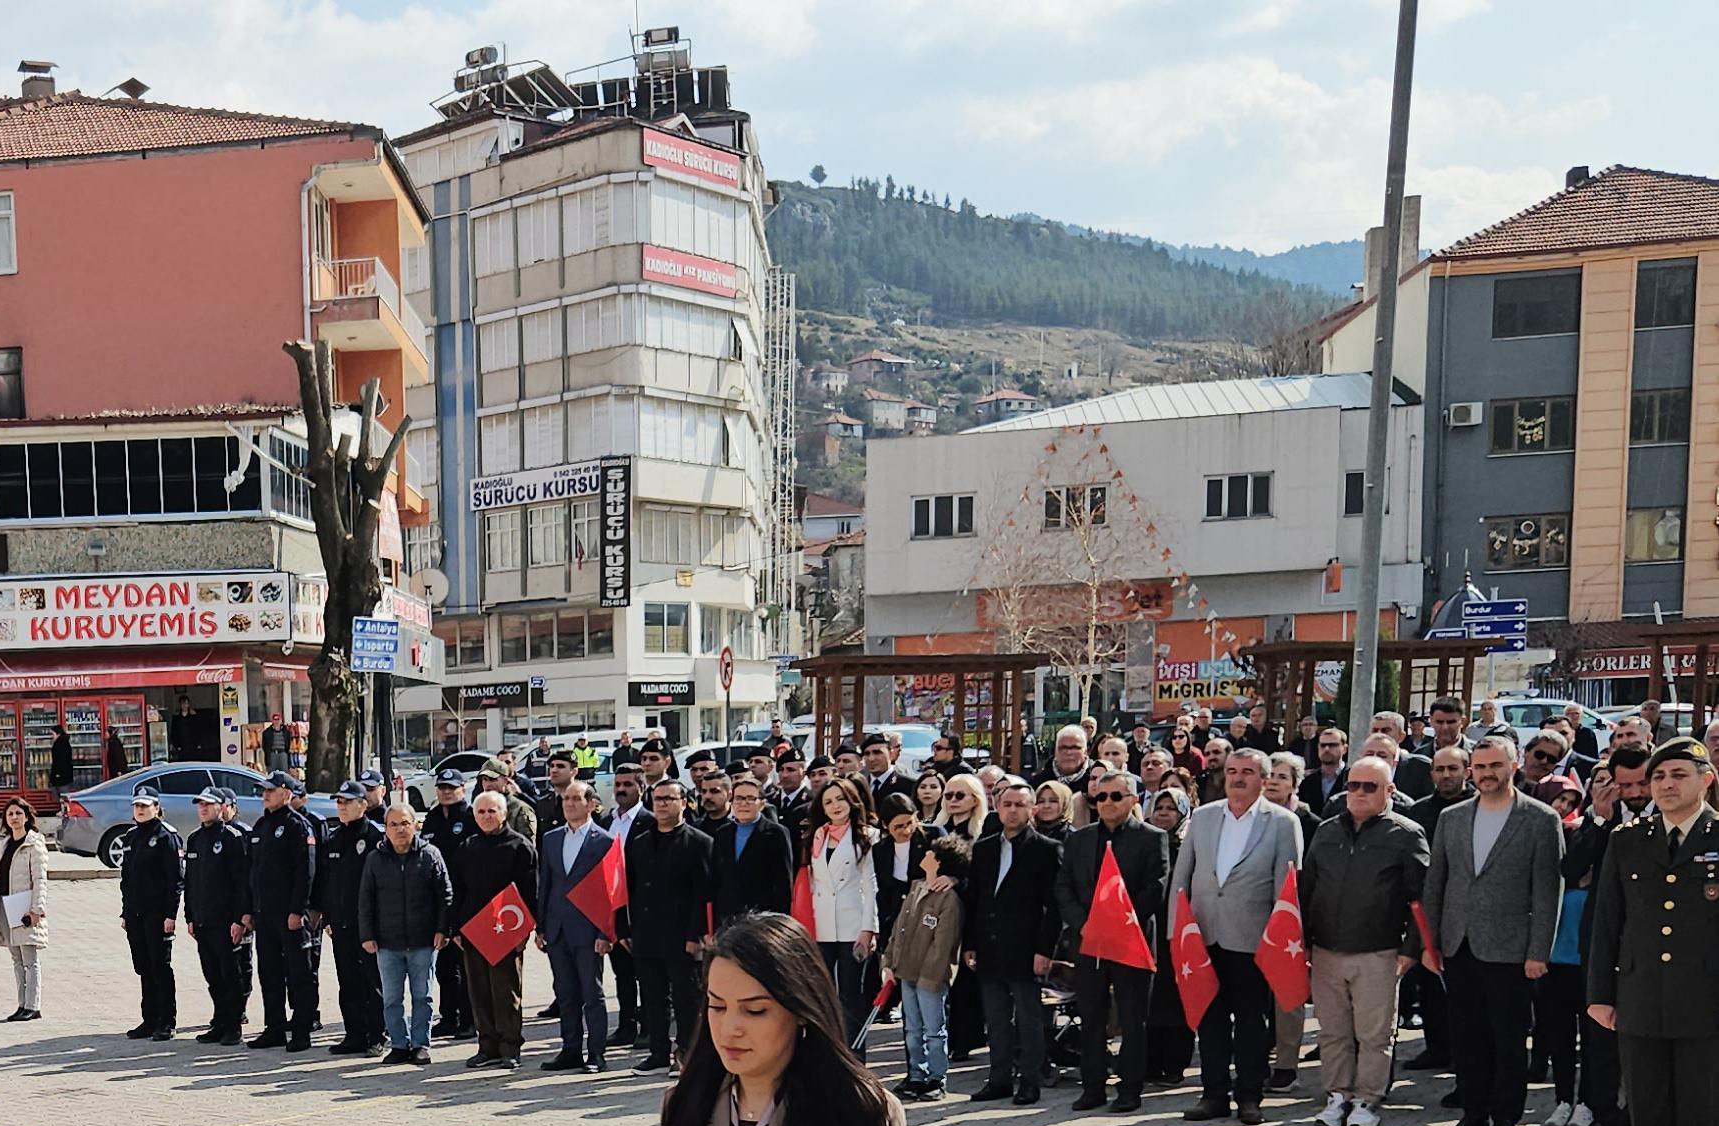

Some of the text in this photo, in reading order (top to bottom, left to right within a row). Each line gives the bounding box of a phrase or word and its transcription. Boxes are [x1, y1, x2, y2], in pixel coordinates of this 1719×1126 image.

[473, 474, 600, 508] SÜRÜCÜ KURSU
[605, 468, 626, 599] SÜRÜCÜ KURSU
[54, 581, 191, 611] MEYDAN
[30, 606, 219, 641] KURUYEMİŞ
[364, 621, 397, 635] Antalya
[363, 640, 395, 653] Isparta
[28, 674, 91, 689] KURUYEMİŞ
[640, 683, 689, 694] MADAME COCO
[459, 684, 521, 698] MADAME COCO
